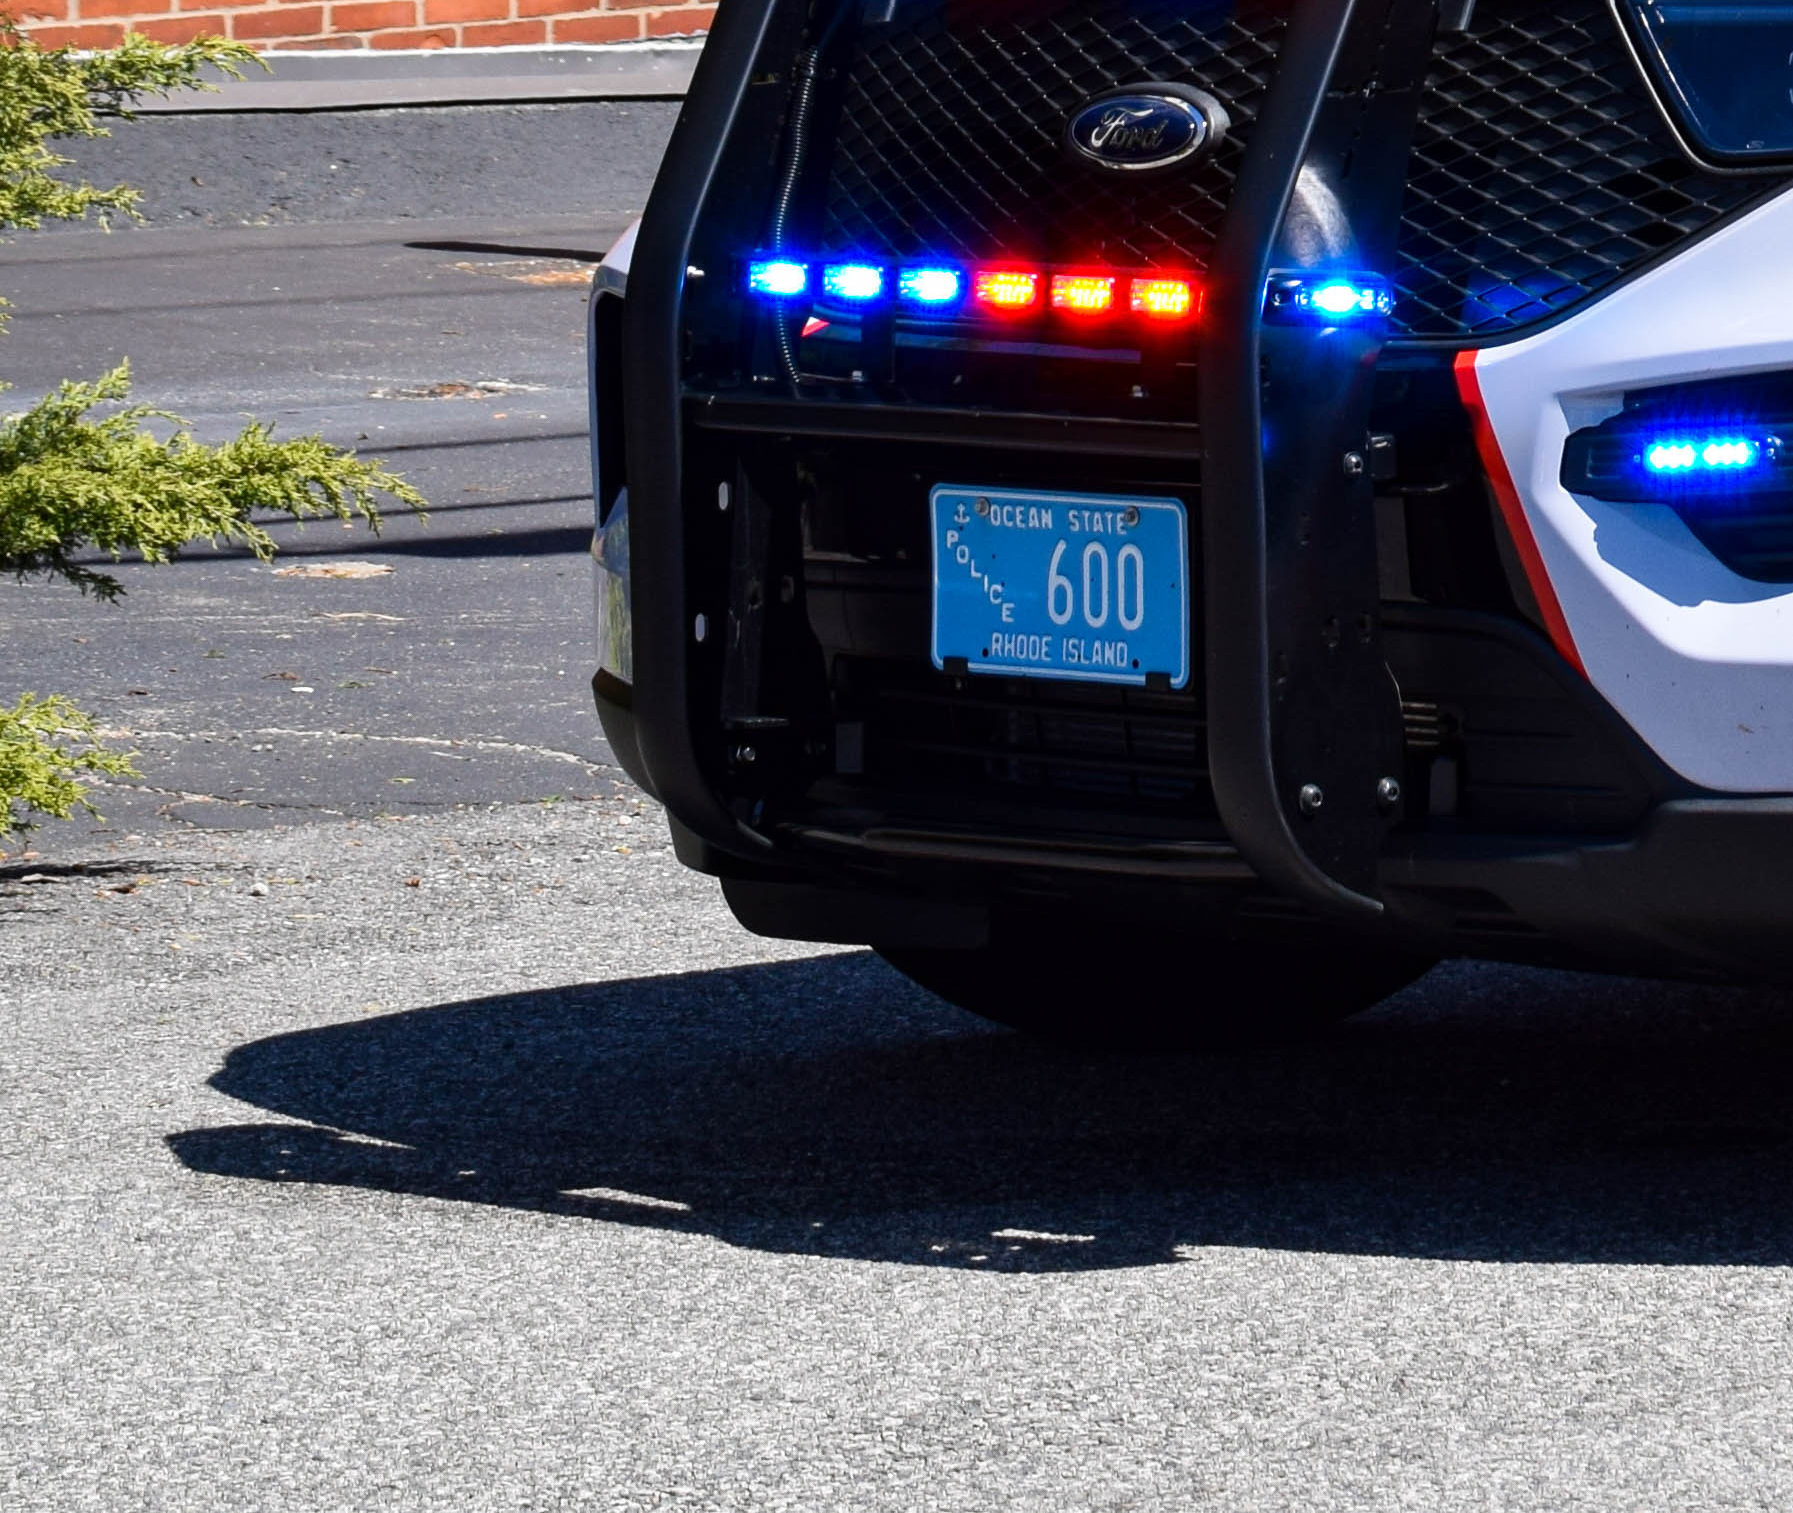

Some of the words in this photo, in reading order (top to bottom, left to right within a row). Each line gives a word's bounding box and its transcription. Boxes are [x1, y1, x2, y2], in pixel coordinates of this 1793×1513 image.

[1091, 108, 1169, 149] Ford
[990, 504, 1054, 529] OCEAN
[1068, 509, 1127, 535] STATE
[946, 530, 1015, 623] POLICE
[1047, 539, 1145, 632] 600
[991, 632, 1053, 661] RHODE
[1062, 638, 1128, 667] ISLAND
